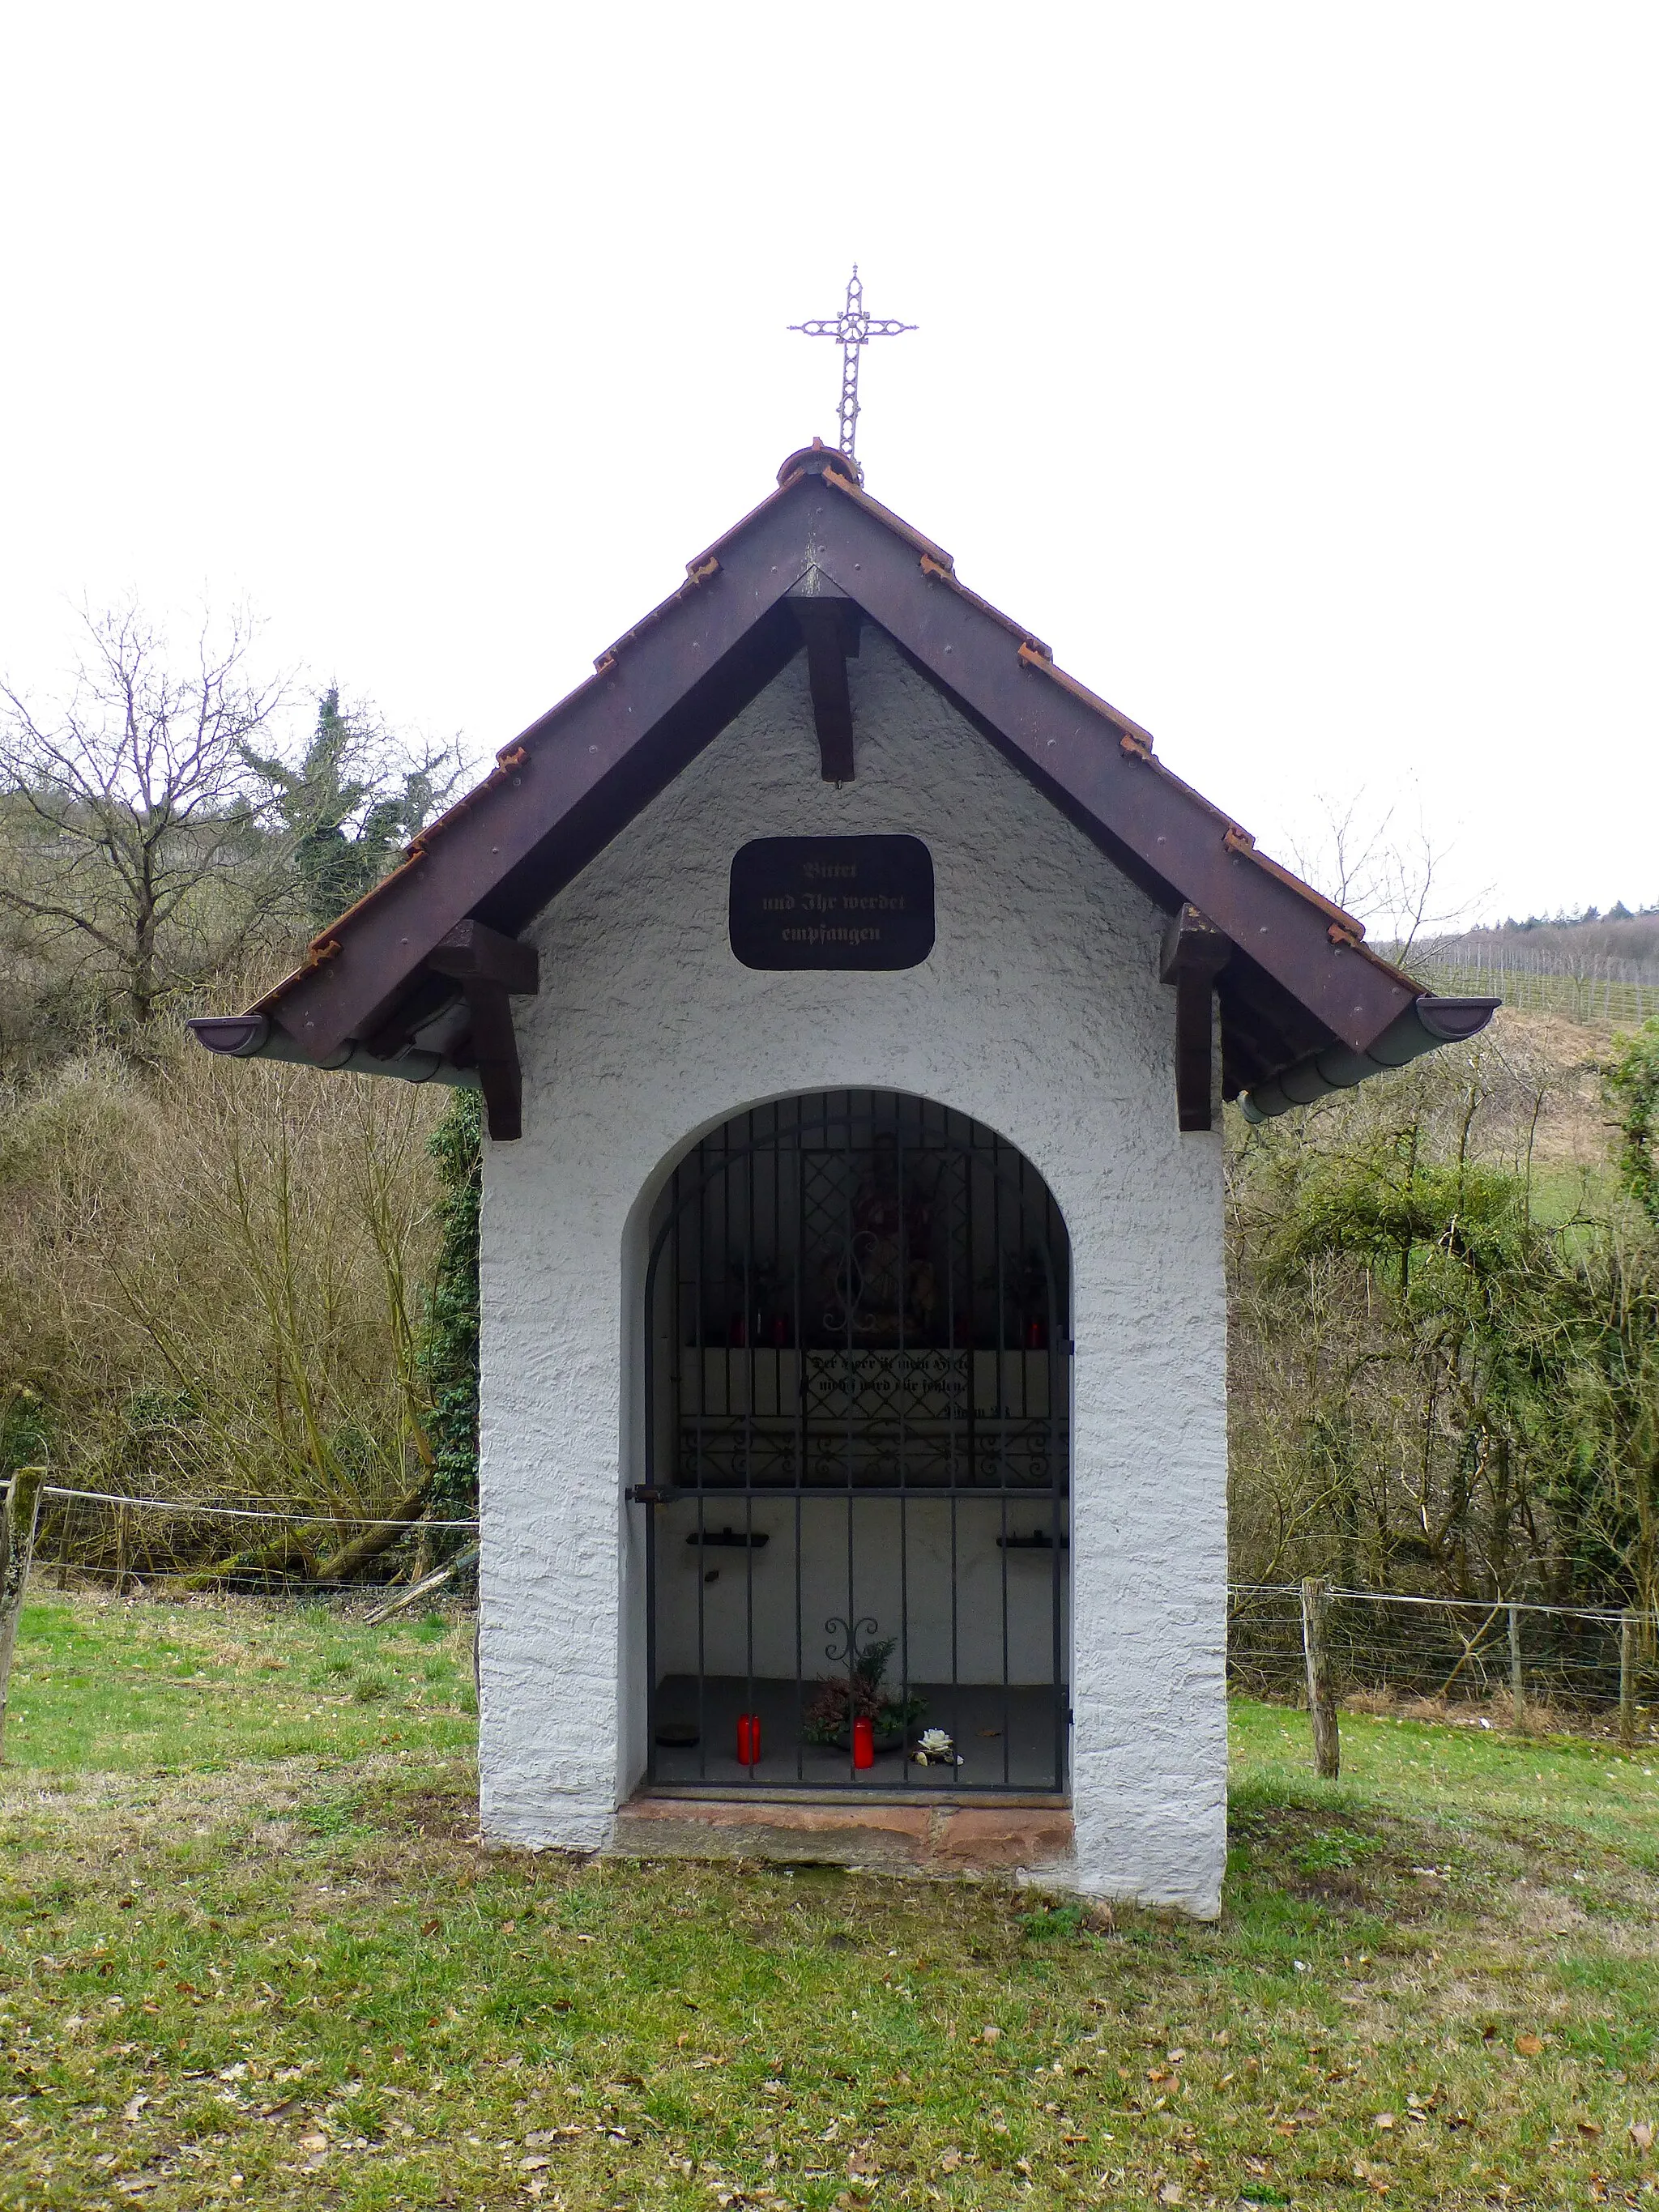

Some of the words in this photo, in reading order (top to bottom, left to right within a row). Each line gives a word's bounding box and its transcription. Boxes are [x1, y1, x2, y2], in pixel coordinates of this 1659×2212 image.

[762, 893, 795, 910] und
[800, 893, 838, 913] Ihr
[842, 893, 906, 910] werdet
[781, 923, 881, 945] empfangen
[932, 1356, 970, 1370] Hite
